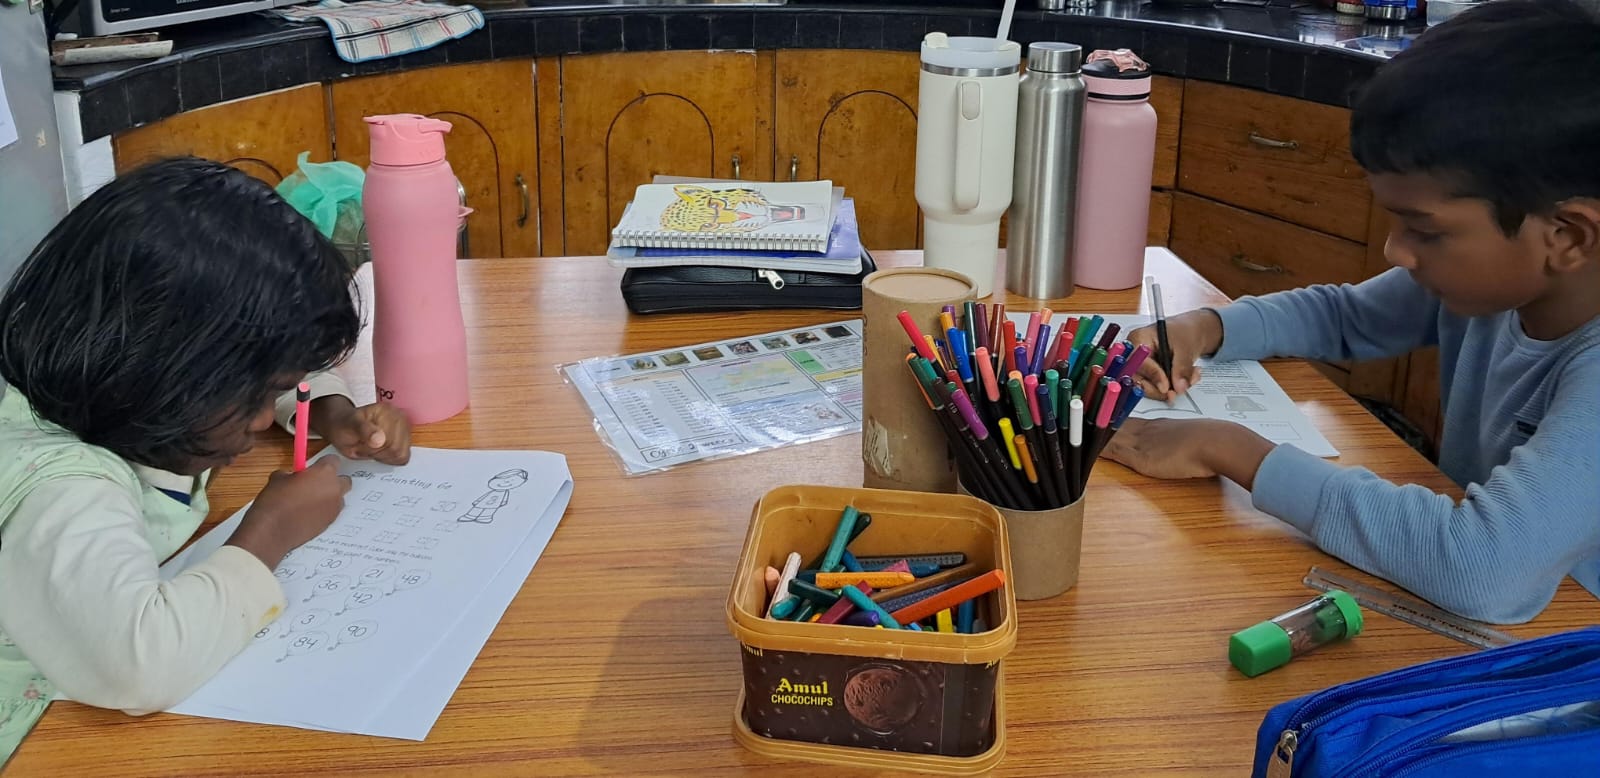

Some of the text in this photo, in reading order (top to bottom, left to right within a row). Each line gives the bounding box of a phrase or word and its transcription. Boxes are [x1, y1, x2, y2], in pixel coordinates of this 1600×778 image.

[380, 475, 432, 489] Counting
[320, 559, 342, 569] 30
[274, 568, 296, 578] 24
[365, 569, 384, 578] 21
[401, 574, 421, 584] 48
[318, 580, 341, 590] 36
[352, 592, 373, 604] 42
[300, 614, 315, 625] 3
[347, 625, 367, 637] 90
[293, 636, 319, 649] 84
[775, 677, 828, 695] Amul
[771, 694, 834, 706] CHOCOCHIPS
